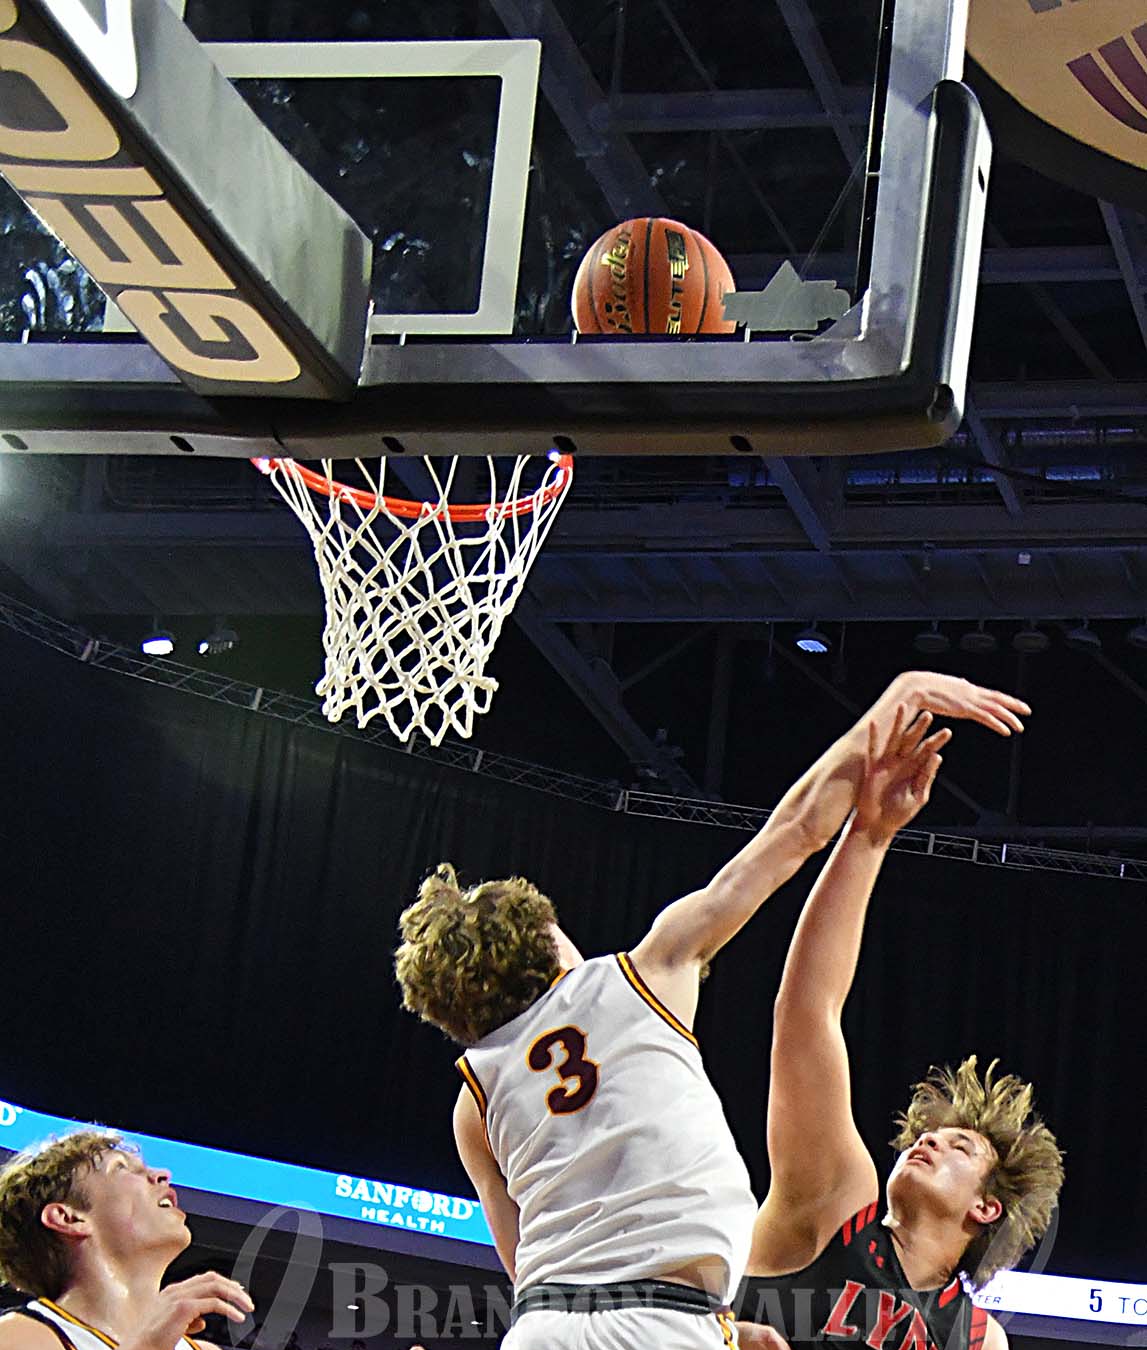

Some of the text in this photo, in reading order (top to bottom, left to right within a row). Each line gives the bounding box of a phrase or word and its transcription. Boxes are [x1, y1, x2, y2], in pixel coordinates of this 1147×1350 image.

[0, 0, 301, 383] GEIC
[525, 1024, 601, 1117] 3
[335, 1174, 474, 1221] SANFORD
[361, 1206, 446, 1233] HEALTH
[1089, 1288, 1103, 1313] 5
